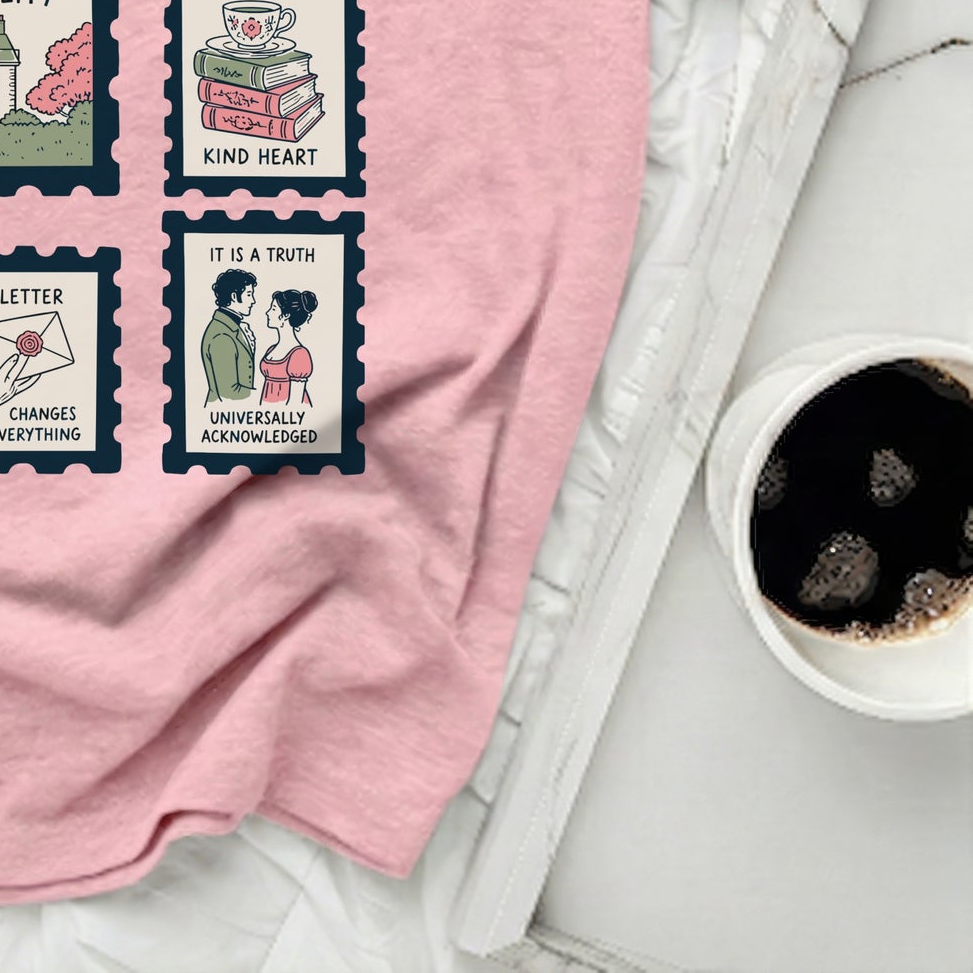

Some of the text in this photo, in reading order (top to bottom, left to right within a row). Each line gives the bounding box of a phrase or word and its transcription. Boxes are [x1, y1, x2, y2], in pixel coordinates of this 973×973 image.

[205, 148, 317, 165] KIND HEART
[211, 247, 314, 262] IT IS A TRUTH
[1, 289, 62, 304] LETTER
[10, 407, 75, 420] CHANGES
[211, 411, 305, 425] UNIVERSALLY
[202, 430, 317, 443] ACKNOWLEDGED
